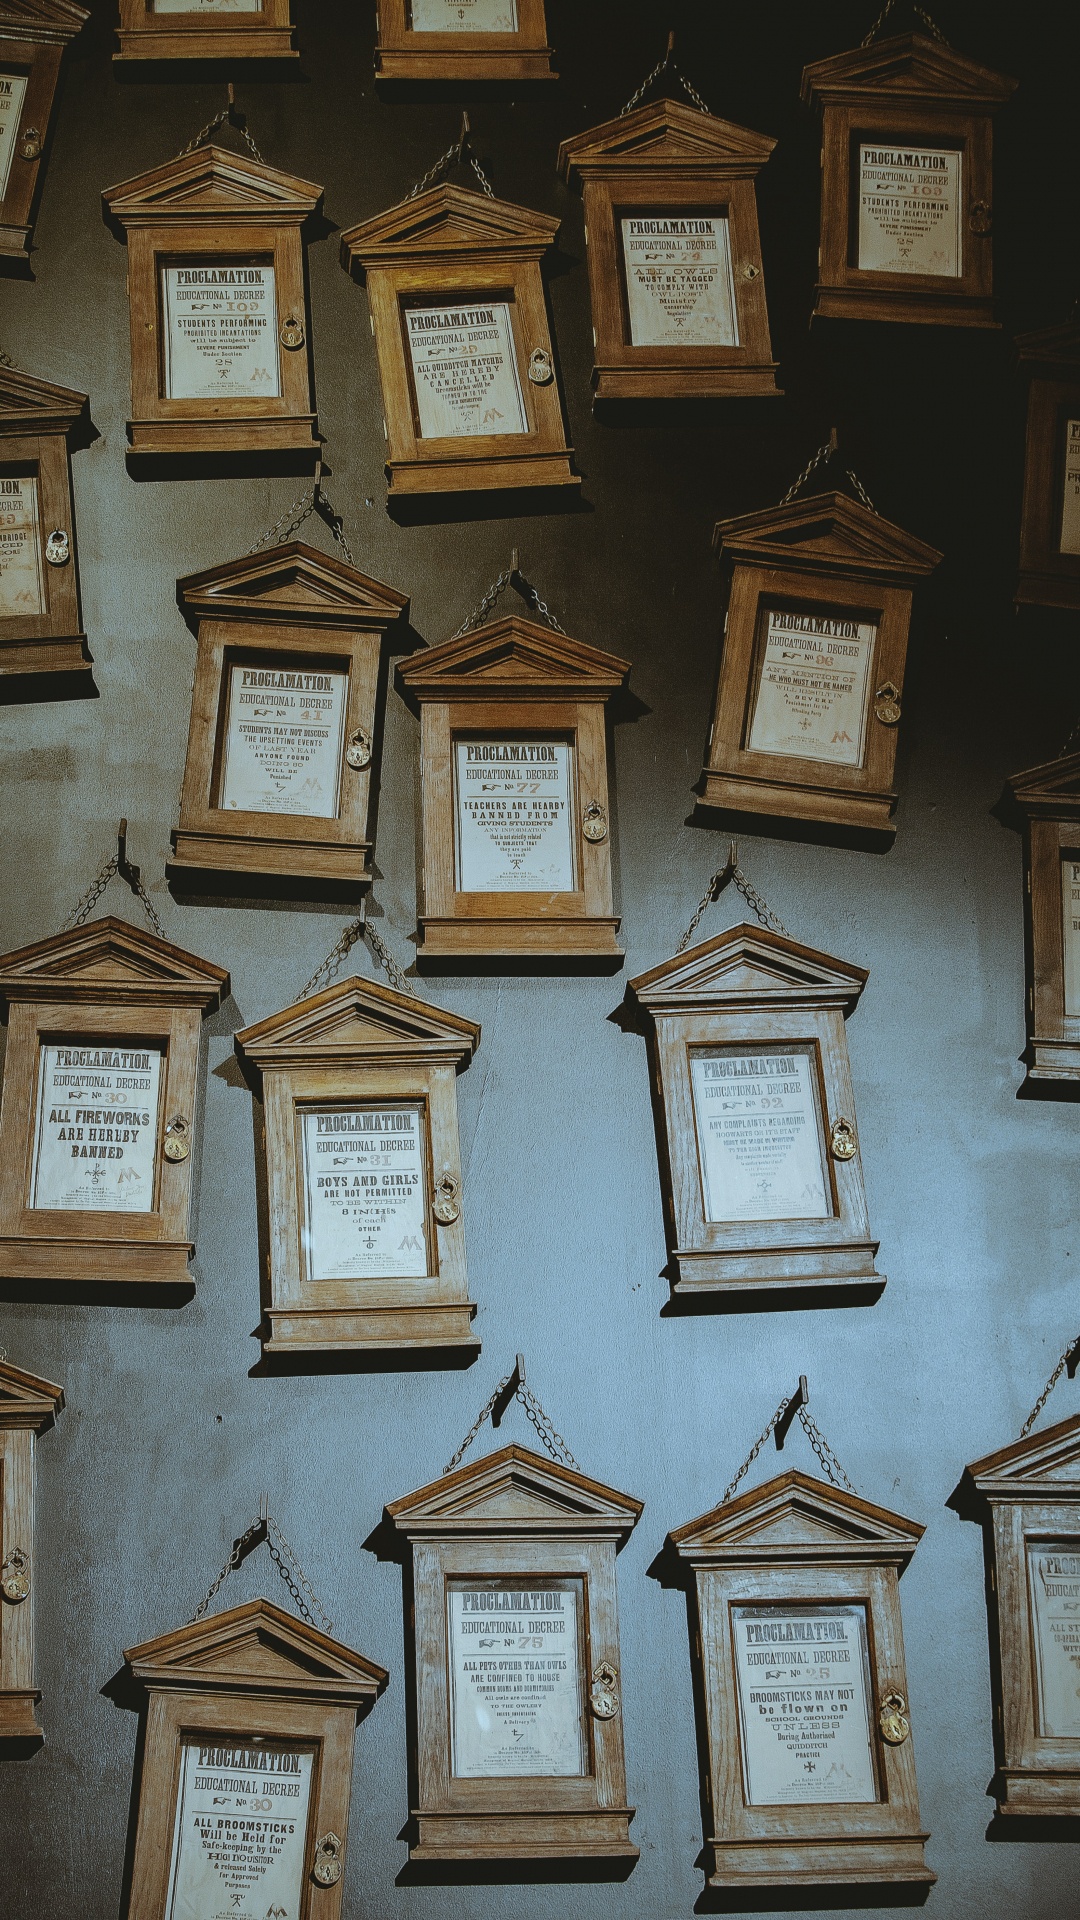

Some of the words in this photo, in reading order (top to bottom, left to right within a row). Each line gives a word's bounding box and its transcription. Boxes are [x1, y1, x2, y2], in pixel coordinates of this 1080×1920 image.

[864, 151, 948, 169] PROCLAMATION.
[862, 170, 914, 182] EDUCATIONAL
[917, 175, 948, 185] DECREE
[863, 198, 899, 207] STUDENTS
[904, 201, 949, 211] PERFORMING
[630, 221, 715, 234] PROCLAMATION.
[630, 241, 682, 250] EDUCATIONAL
[686, 241, 716, 250] DECREE
[177, 270, 264, 283] PROCLAMATION.
[176, 291, 230, 300] EDUCATIONAL
[234, 291, 265, 299] DECREE
[221, 319, 267, 327] PERFORMING
[410, 310, 496, 330] PROCLAMATION.
[412, 334, 465, 347] EDUCATIONAL
[468, 330, 499, 341] DECREE
[418, 365, 430, 373] ALL
[471, 357, 503, 366] MATCHES
[423, 372, 445, 380] ARE
[452, 366, 500, 378] HEREBY
[430, 374, 494, 387] CANCELLED
[772, 613, 861, 639] PROCLAMATION.
[768, 636, 823, 652] EDUCATIONAL
[827, 644, 859, 657] DECREE
[242, 671, 333, 691] PROCLAMATION.
[778, 675, 791, 683] WHO
[832, 682, 852, 691] NAMED
[239, 694, 295, 707] EDUCATIONAL
[299, 698, 332, 709] DECREE
[239, 725, 271, 734] STUDENTS
[304, 730, 328, 738] DISCUSS
[259, 736, 294, 745] UPSETTING
[467, 746, 557, 761] PROCLAMATION.
[466, 770, 522, 779] EDUCATIONAL
[526, 770, 558, 779] DECREE
[517, 783, 541, 793] 77
[464, 802, 506, 810] TEACHERS
[56, 1050, 151, 1070] PROCLAMATION.
[703, 1058, 798, 1078] PROCLAMATION.
[53, 1075, 112, 1088] EDUCATIONAL
[116, 1078, 150, 1089] DECREE
[704, 1084, 763, 1098] EDUCATIONAL
[767, 1082, 801, 1094] DECREE
[105, 1093, 127, 1103] 30
[49, 1110, 70, 1123] ALL
[75, 1110, 149, 1126] FIREWORKS
[317, 1115, 414, 1132] PROCLAMATION.
[710, 1121, 722, 1130] ANY
[724, 1119, 766, 1129] COMPLAINTS
[57, 1128, 83, 1140] ARE
[71, 1145, 123, 1159] BANNED
[316, 1141, 376, 1153] EDUCATIONAL
[380, 1140, 415, 1151] DECREE
[317, 1177, 347, 1187] BOYS
[353, 1176, 377, 1186] AND
[324, 1190, 339, 1198] ARE
[345, 1189, 360, 1197] NOT
[366, 1188, 412, 1196] PERMITTED
[463, 1593, 564, 1611] PROCLAMATION.
[461, 1622, 524, 1634] EDUCATIONAL
[528, 1621, 565, 1633] DECREE
[746, 1622, 848, 1642] PROCLAMATION.
[518, 1637, 544, 1649] 75
[747, 1652, 809, 1666] EDUCATIONAL
[814, 1650, 850, 1663] DECREE
[463, 1662, 477, 1671] ALL
[479, 1662, 497, 1670] PETS
[499, 1662, 522, 1670] OTHER
[524, 1661, 545, 1670] THAN
[547, 1661, 567, 1670] OWLS
[471, 1674, 484, 1682] ARE
[487, 1674, 522, 1682] CONFINED
[526, 1674, 535, 1682] TO
[537, 1673, 560, 1681] HOUSE
[750, 1691, 812, 1703] BROOMSTICKS
[815, 1690, 834, 1700] MAY
[838, 1689, 855, 1699] NOT
[759, 1704, 774, 1715] be
[781, 1704, 824, 1713] flown
[830, 1704, 848, 1712] on
[772, 1722, 840, 1731] UNLESS
[777, 1733, 799, 1741] During
[198, 1748, 301, 1773] PROCLAMATION.
[194, 1777, 257, 1794] EDUCATIONAL
[262, 1782, 300, 1797] DECREE
[250, 1799, 272, 1811] 30
[194, 1818, 212, 1827] ALL
[217, 1820, 294, 1833] BROOMSTICKS
[200, 1830, 221, 1839] Will
[226, 1831, 237, 1841] be
[242, 1832, 265, 1843] Held
[269, 1835, 286, 1844] for
[202, 1841, 253, 1853] Safe-keeping
[256, 1845, 266, 1854] by
[269, 1845, 281, 1854] the
[231, 1873, 259, 1881] Approved
